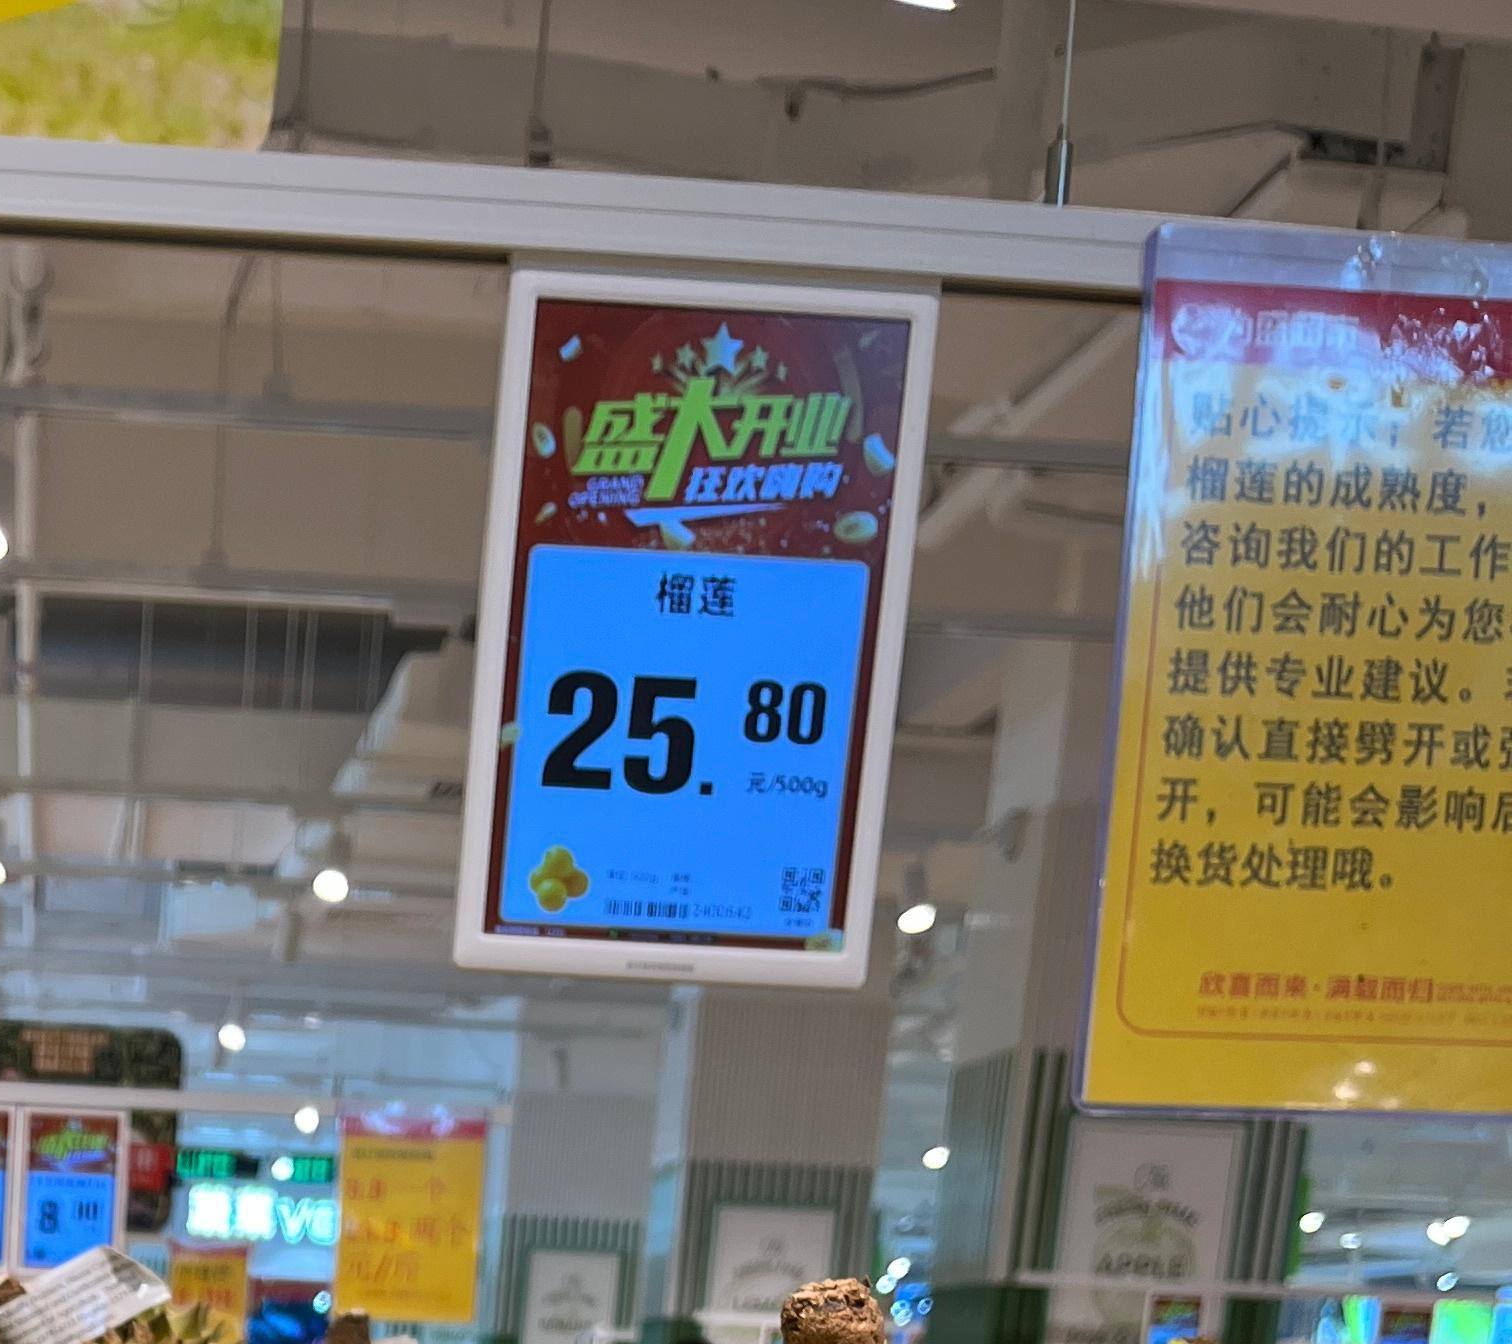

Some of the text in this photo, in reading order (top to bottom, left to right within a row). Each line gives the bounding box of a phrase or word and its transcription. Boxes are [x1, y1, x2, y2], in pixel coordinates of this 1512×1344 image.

[571, 377, 851, 500] 盛大开业
[1181, 520, 1512, 581] 咨询我们的工作
[656, 571, 738, 619] 榴莲
[1167, 648, 1512, 704] 提供专业建议。
[743, 679, 827, 747] 80
[1150, 839, 1393, 891] 换货处理哦。
